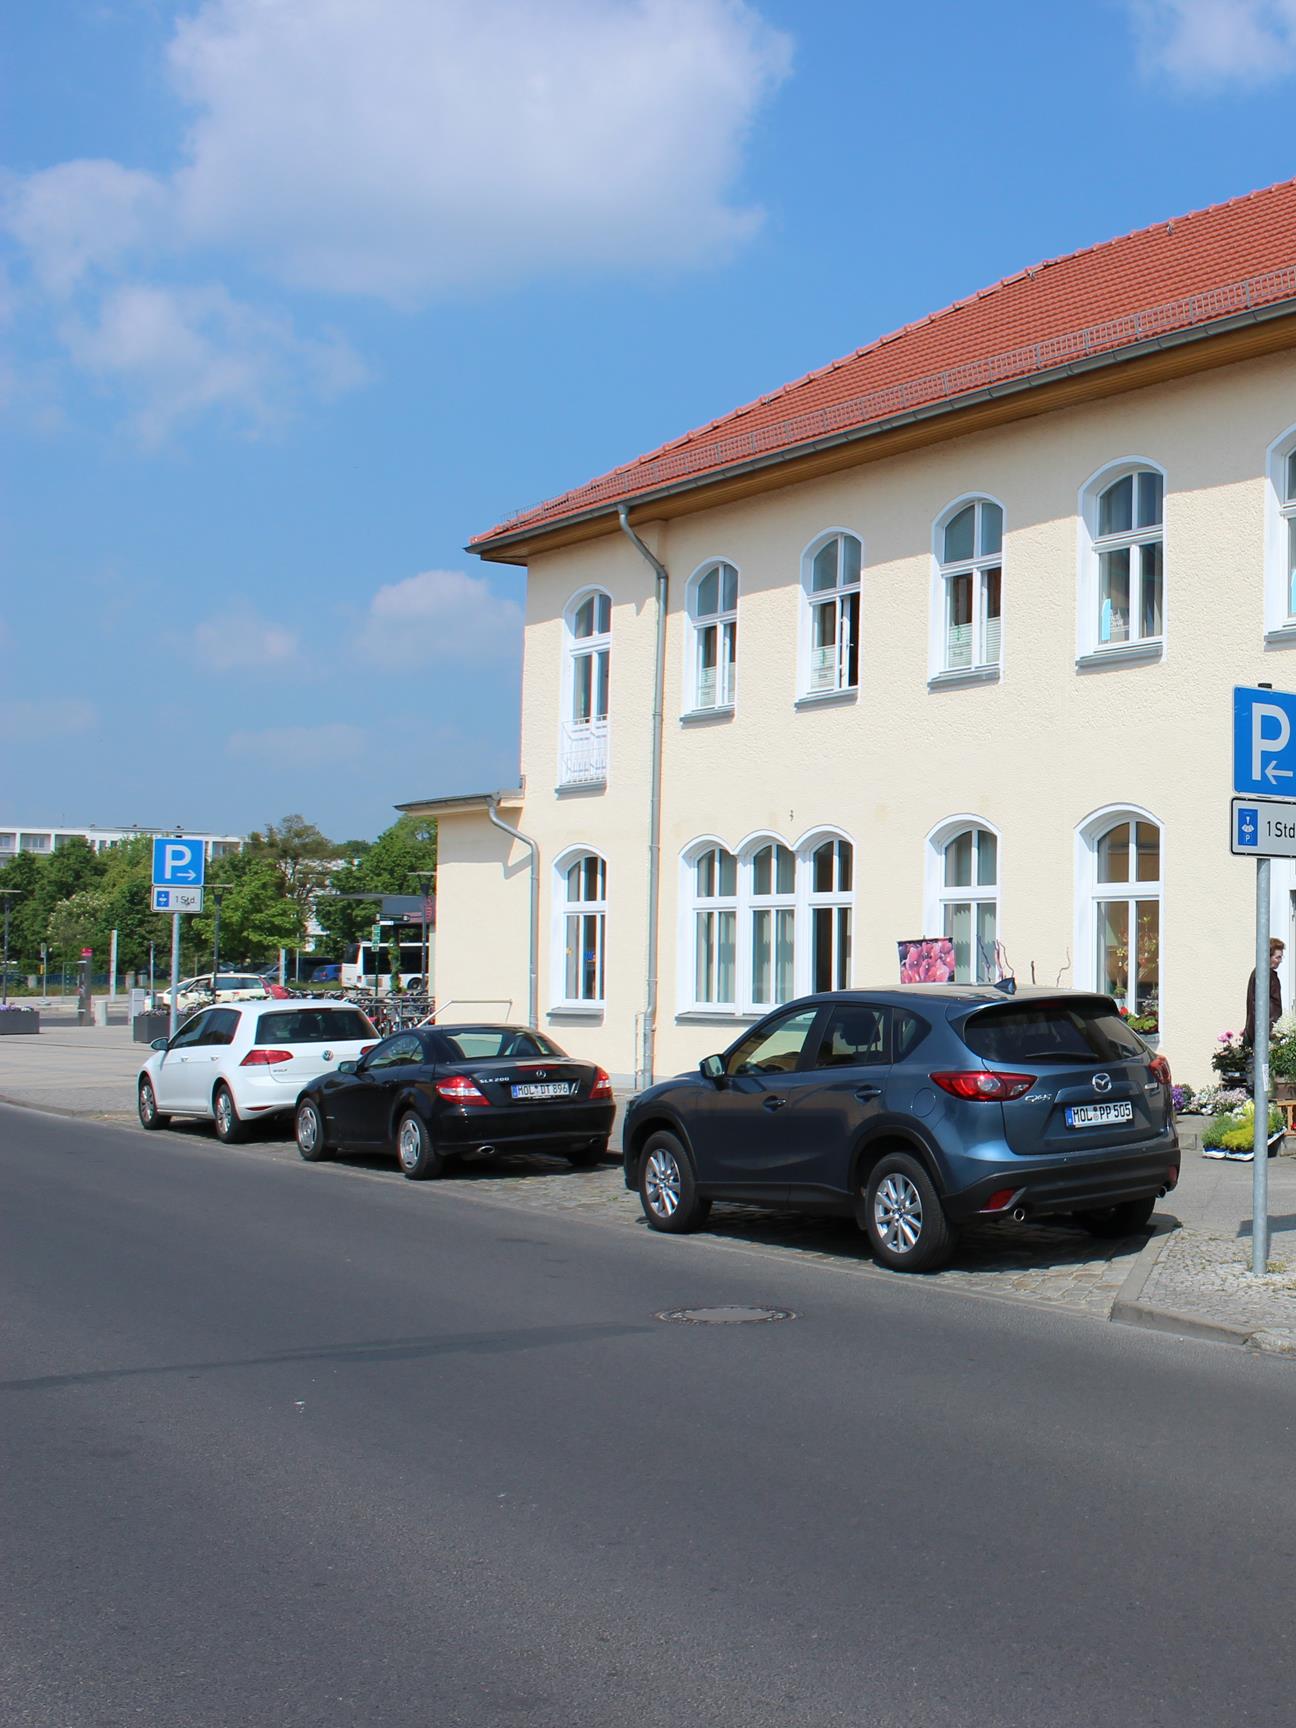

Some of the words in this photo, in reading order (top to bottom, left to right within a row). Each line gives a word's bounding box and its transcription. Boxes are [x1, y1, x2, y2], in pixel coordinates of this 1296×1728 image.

[1251, 702, 1291, 781] P
[1266, 820, 1271, 837] 1
[164, 844, 192, 879] P
[517, 1084, 535, 1096] MOL
[540, 1083, 551, 1095] DT
[552, 1082, 568, 1094] 896
[1072, 1107, 1093, 1123] MOL
[1098, 1105, 1112, 1120] PP
[1113, 1103, 1131, 1118] 505
